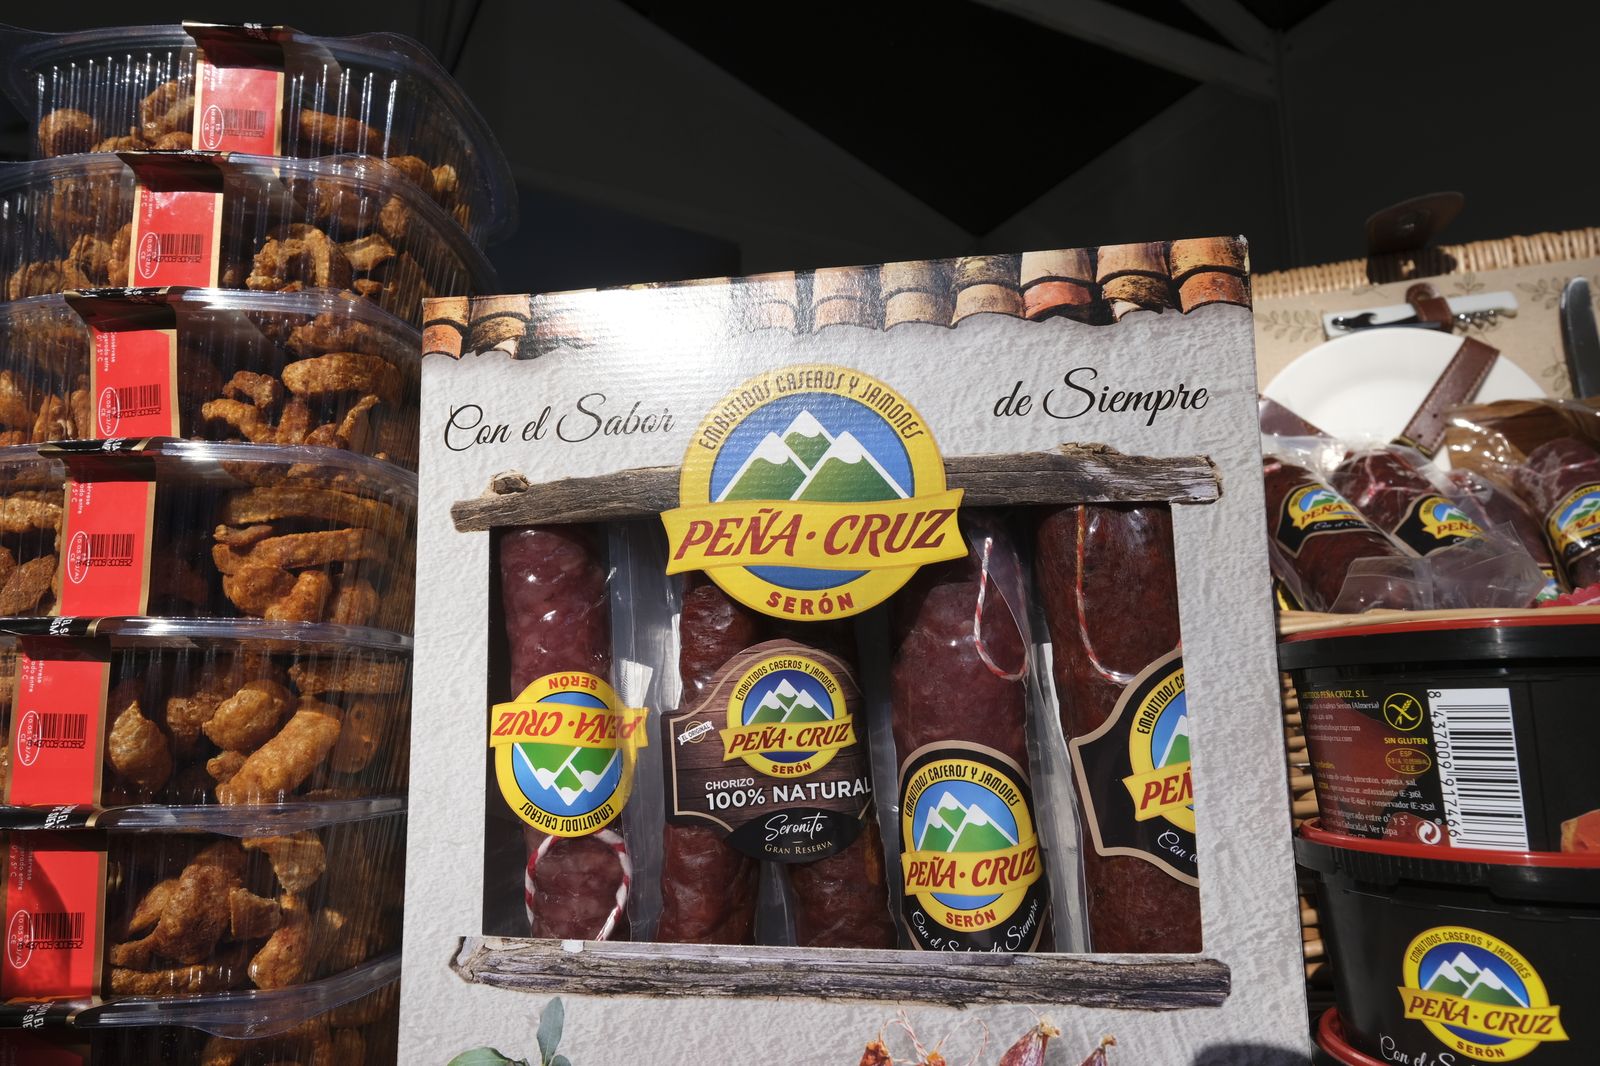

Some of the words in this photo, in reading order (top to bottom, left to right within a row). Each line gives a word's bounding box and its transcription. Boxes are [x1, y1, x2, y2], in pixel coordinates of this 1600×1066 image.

[699, 380, 770, 450] EMBUTIDOS
[776, 370, 845, 392] CASEROS
[848, 374, 858, 388] Y
[862, 382, 926, 440] JAMONES
[993, 380, 1033, 418] de
[1043, 367, 1209, 426] Siempre
[444, 404, 512, 452] Con
[522, 406, 552, 442] el
[556, 392, 676, 442] Sabor
[673, 508, 803, 561] PEÑA
[823, 508, 956, 558] CRUZ
[766, 592, 854, 616] SERÓN
[548, 676, 598, 690] SERÓN
[736, 666, 768, 701] EMBUTIDOS
[768, 660, 802, 671] CASEROS
[810, 666, 838, 694] JAMONES
[1428, 690, 1442, 698] 8
[1136, 680, 1176, 734] EMBUTIDOS
[492, 710, 563, 737] CRUZ
[682, 734, 688, 742] EL
[688, 724, 710, 738] ORIGINAL
[728, 726, 786, 754] PEÑA
[796, 722, 851, 748] CRUZ
[1431, 710, 1452, 770] 437009
[772, 762, 812, 774] SERÓN
[705, 778, 754, 790] CHORIZO
[706, 788, 766, 810] 100%
[773, 776, 872, 803] NATURAL
[906, 772, 928, 818] EMBUTIDOS
[928, 764, 969, 782] CASEROS
[970, 768, 978, 779] Y
[978, 771, 1020, 806] JAMONES
[519, 802, 558, 830] CASEROS
[560, 804, 614, 832] EMBUTIDOS
[1366, 814, 1382, 822] entre
[1442, 778, 1462, 838] 917466
[764, 812, 828, 842] Seronito
[1369, 825, 1380, 834] Ver
[1382, 826, 1398, 837] tapa
[1158, 830, 1185, 858] Con
[906, 857, 957, 888] PEÑA
[972, 846, 1038, 888] CRUZ
[912, 909, 929, 939] Con
[930, 937, 942, 949] el
[1005, 899, 1039, 952] Siempre
[946, 909, 996, 927] SERÓN
[10, 934, 16, 944] CE
[1410, 933, 1442, 964] EMBUTIDOS
[1443, 932, 1483, 946] CASEROS
[1486, 940, 1492, 948] Y
[1494, 944, 1532, 980] JAMONES
[34, 1018, 44, 1028] EL
[1409, 996, 1470, 1026] PEÑA
[1484, 1010, 1558, 1035] CRUZ
[1379, 1033, 1410, 1064] Con
[1456, 1040, 1506, 1058] SERÓN
